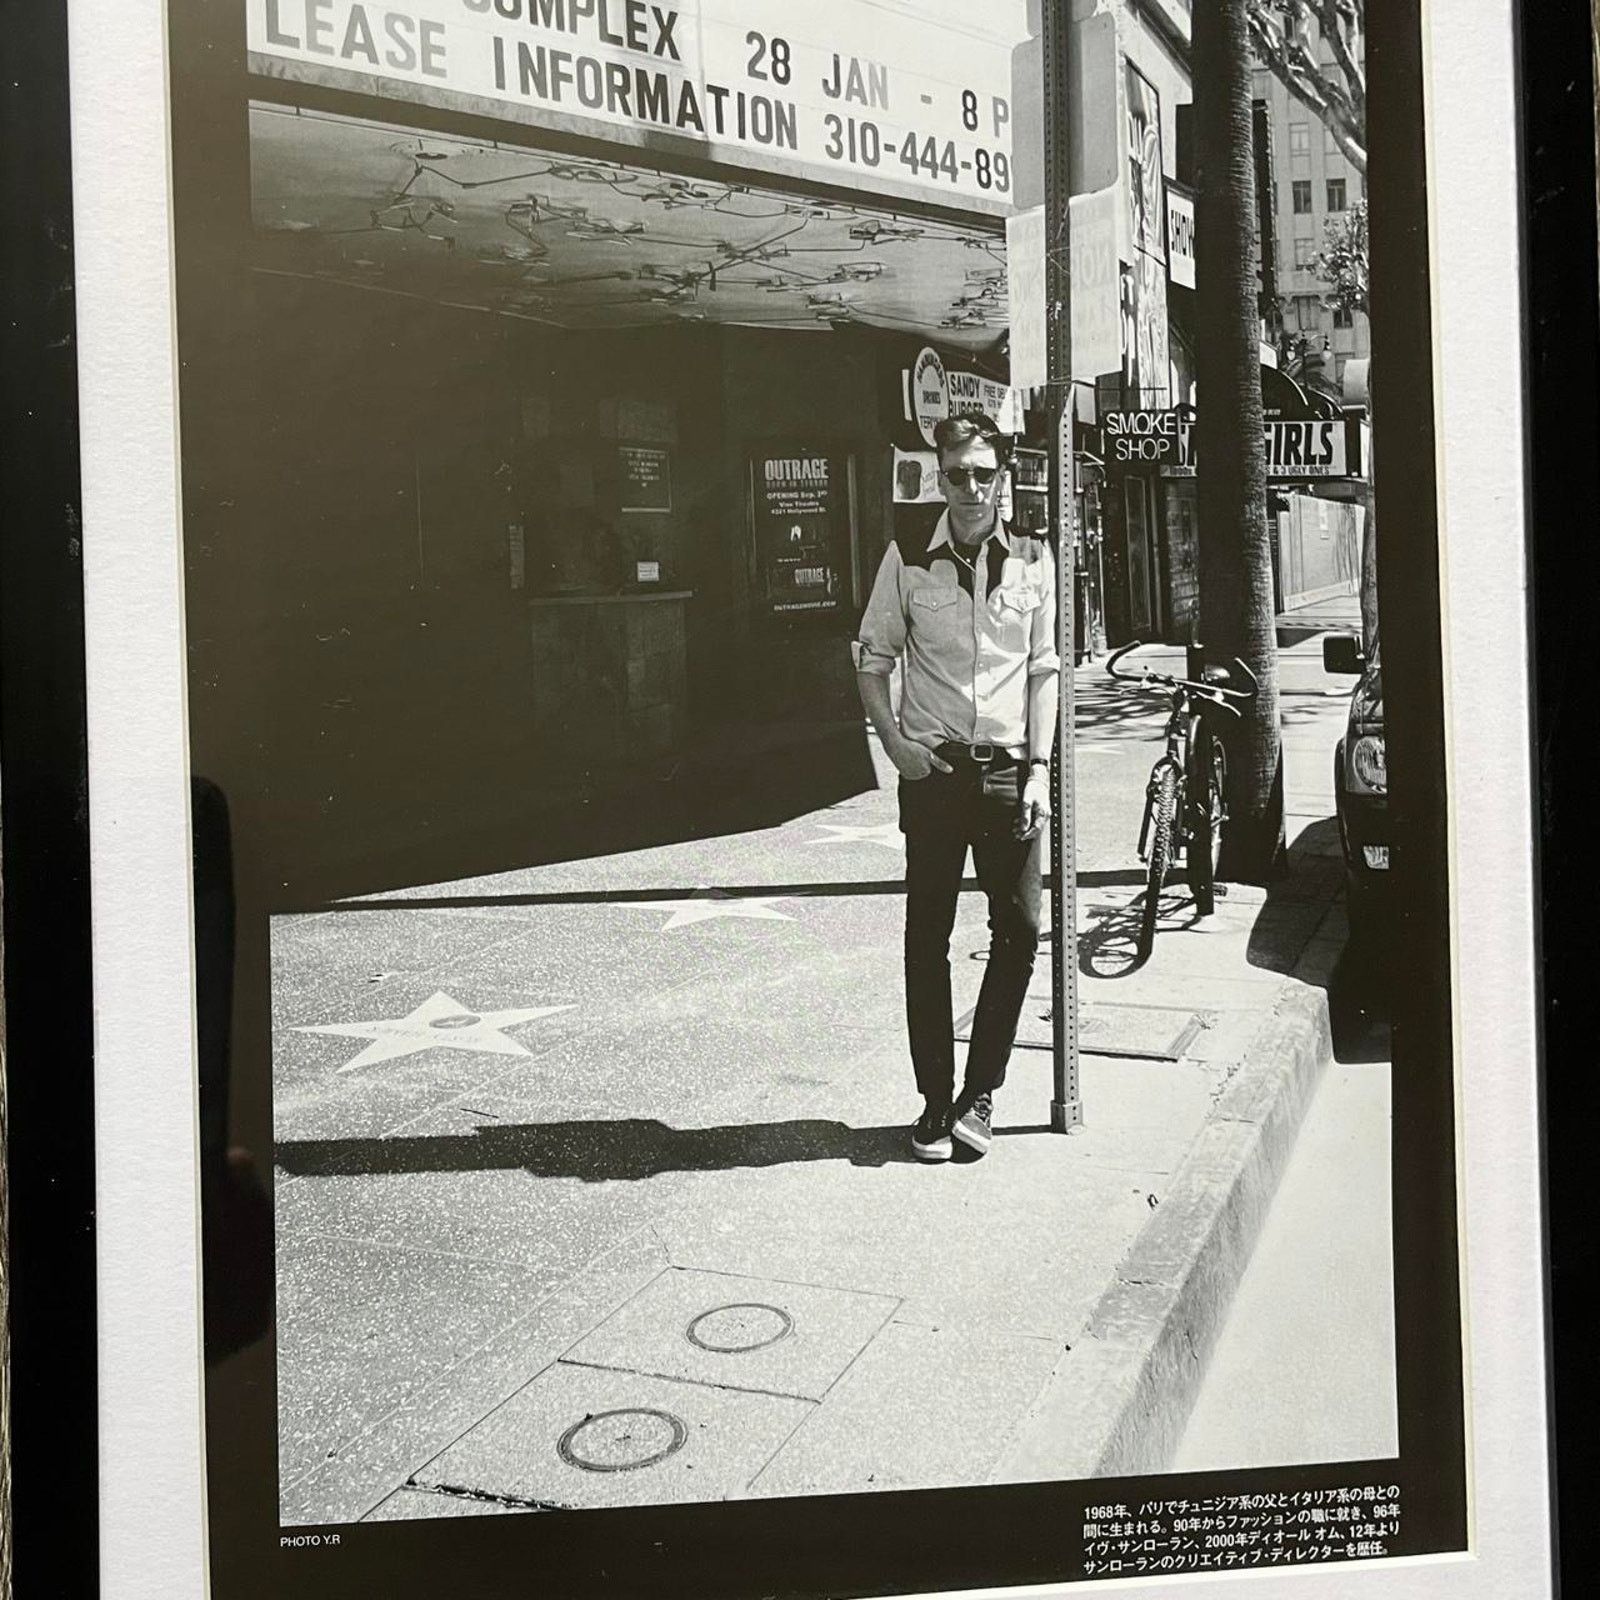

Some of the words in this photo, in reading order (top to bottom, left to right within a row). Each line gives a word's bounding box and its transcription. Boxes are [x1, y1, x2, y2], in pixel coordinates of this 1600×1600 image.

[266, 0, 448, 78] LEASE
[493, 36, 798, 151] INFORMATION
[464, 0, 681, 61] MPLEX
[746, 31, 791, 86] 28
[822, 54, 889, 110] JAN
[962, 89, 979, 132] 8
[950, 373, 980, 399] SANDY
[1107, 412, 1177, 436] SMOKE
[1116, 438, 1170, 460] SHOP
[765, 459, 829, 481] OUTRAGE
[280, 1536, 320, 1547] PHOTO
[323, 1534, 341, 1545] Y.R
